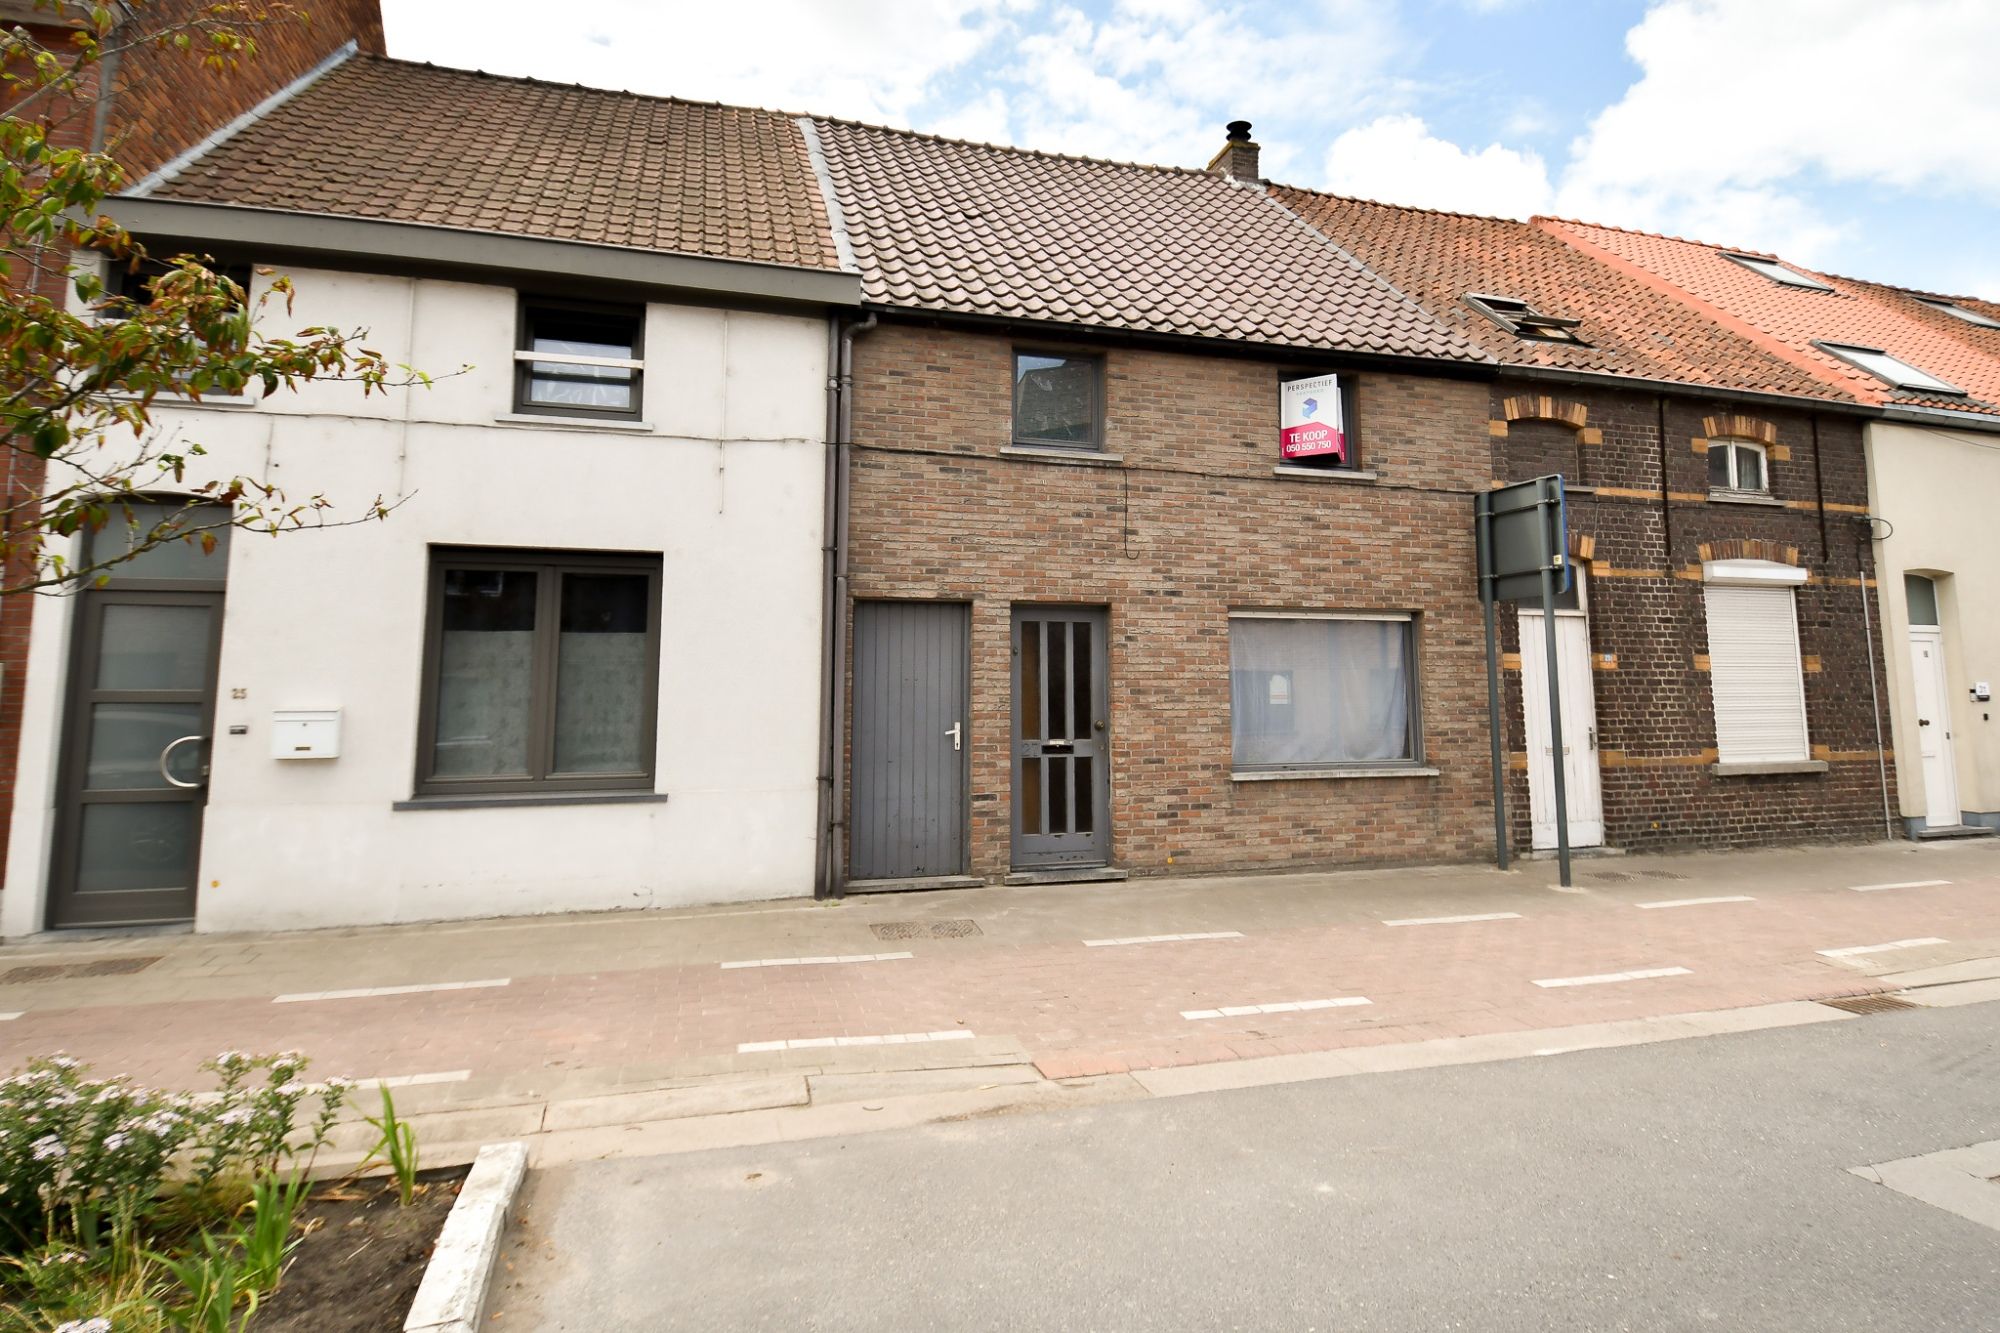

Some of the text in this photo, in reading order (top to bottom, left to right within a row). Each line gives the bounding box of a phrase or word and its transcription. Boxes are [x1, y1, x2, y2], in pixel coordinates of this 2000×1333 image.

[1287, 379, 1333, 392] PERSPECTIEF
[1289, 430, 1328, 443] TE KOOP
[1286, 443, 1300, 452] 050
[1302, 442, 1316, 451] 550
[1317, 440, 1331, 449] 750
[231, 688, 248, 699] 25
